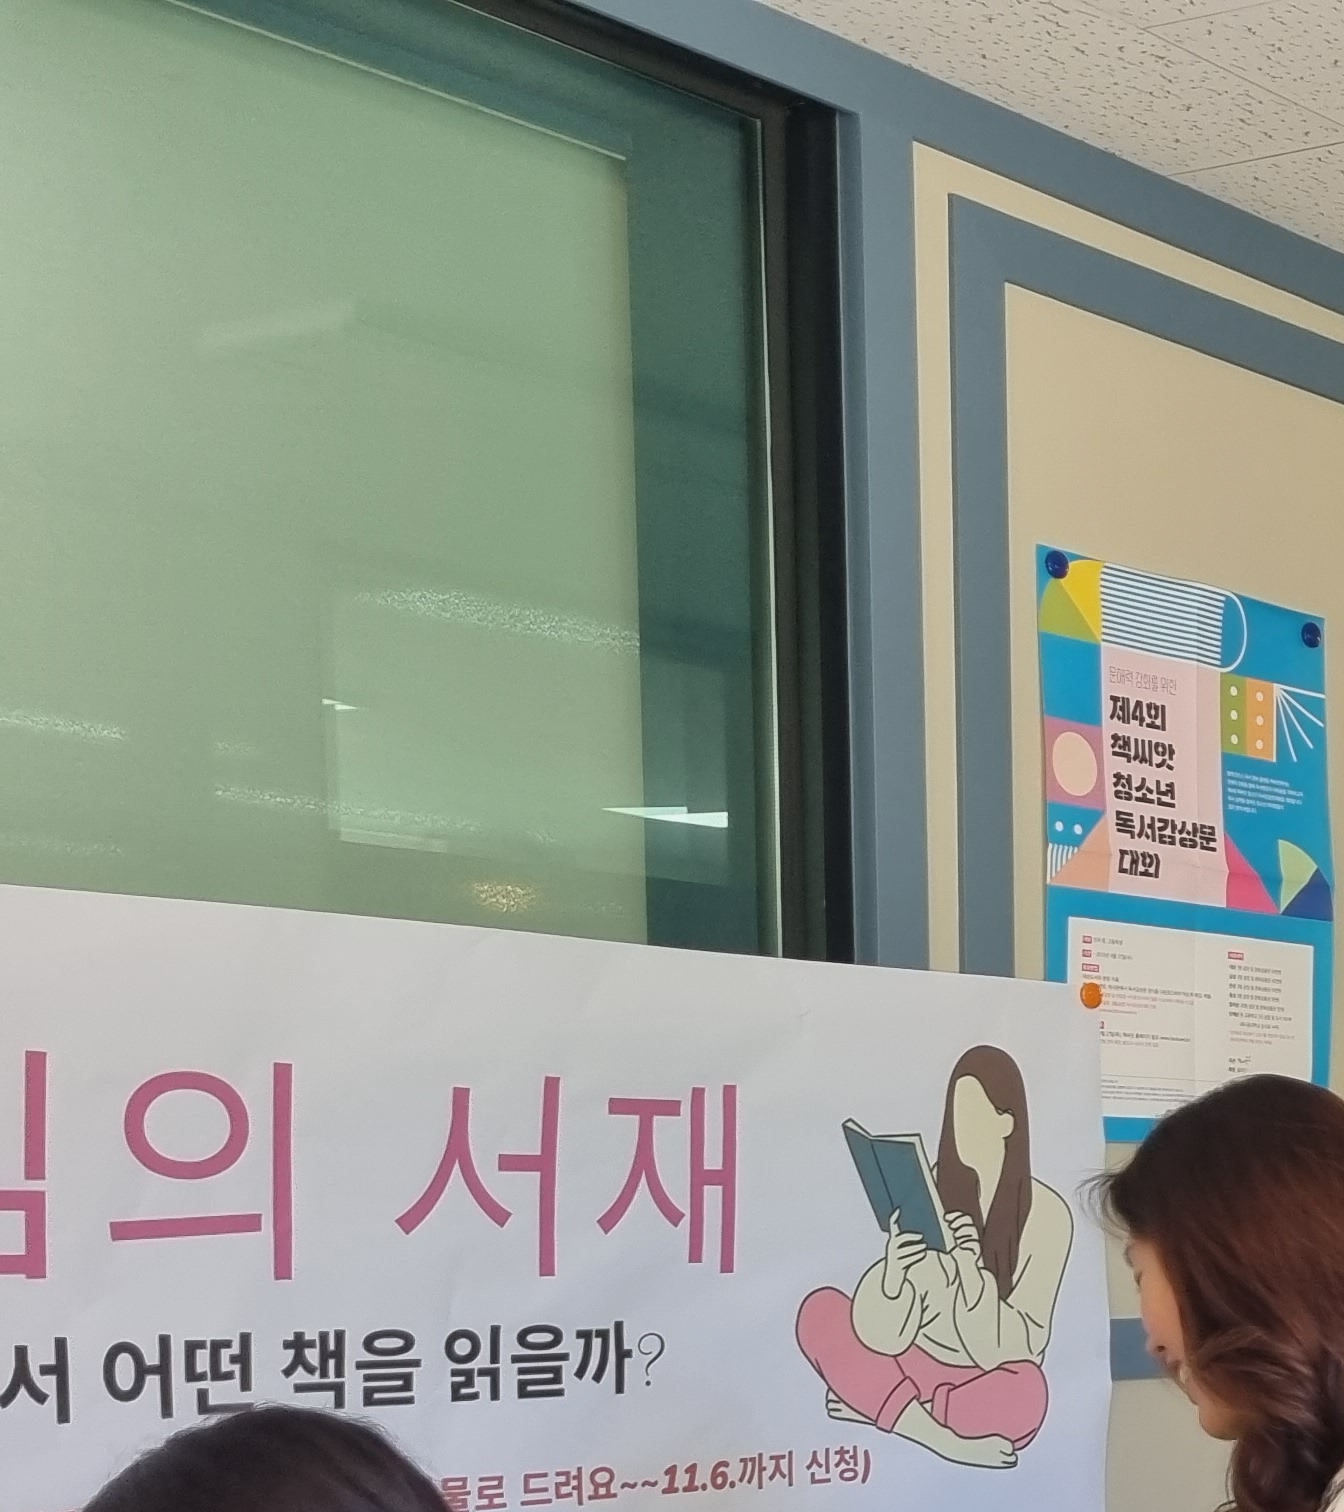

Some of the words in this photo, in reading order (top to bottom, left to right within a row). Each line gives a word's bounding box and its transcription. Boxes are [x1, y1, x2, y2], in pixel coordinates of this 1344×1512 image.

[1109, 694, 1167, 731] 제4회
[1110, 732, 1176, 771] 책씨앗
[1112, 771, 1176, 809] 청소년
[1115, 810, 1218, 852] 독서감상문
[1118, 848, 1161, 878] 대회
[0, 1049, 293, 1283] 의
[394, 1075, 741, 1278] 서재
[103, 1331, 254, 1419] 어떤
[281, 1327, 424, 1409] 책을
[443, 1320, 668, 1402] 읽을까?
[805, 1445, 872, 1486] 신청)
